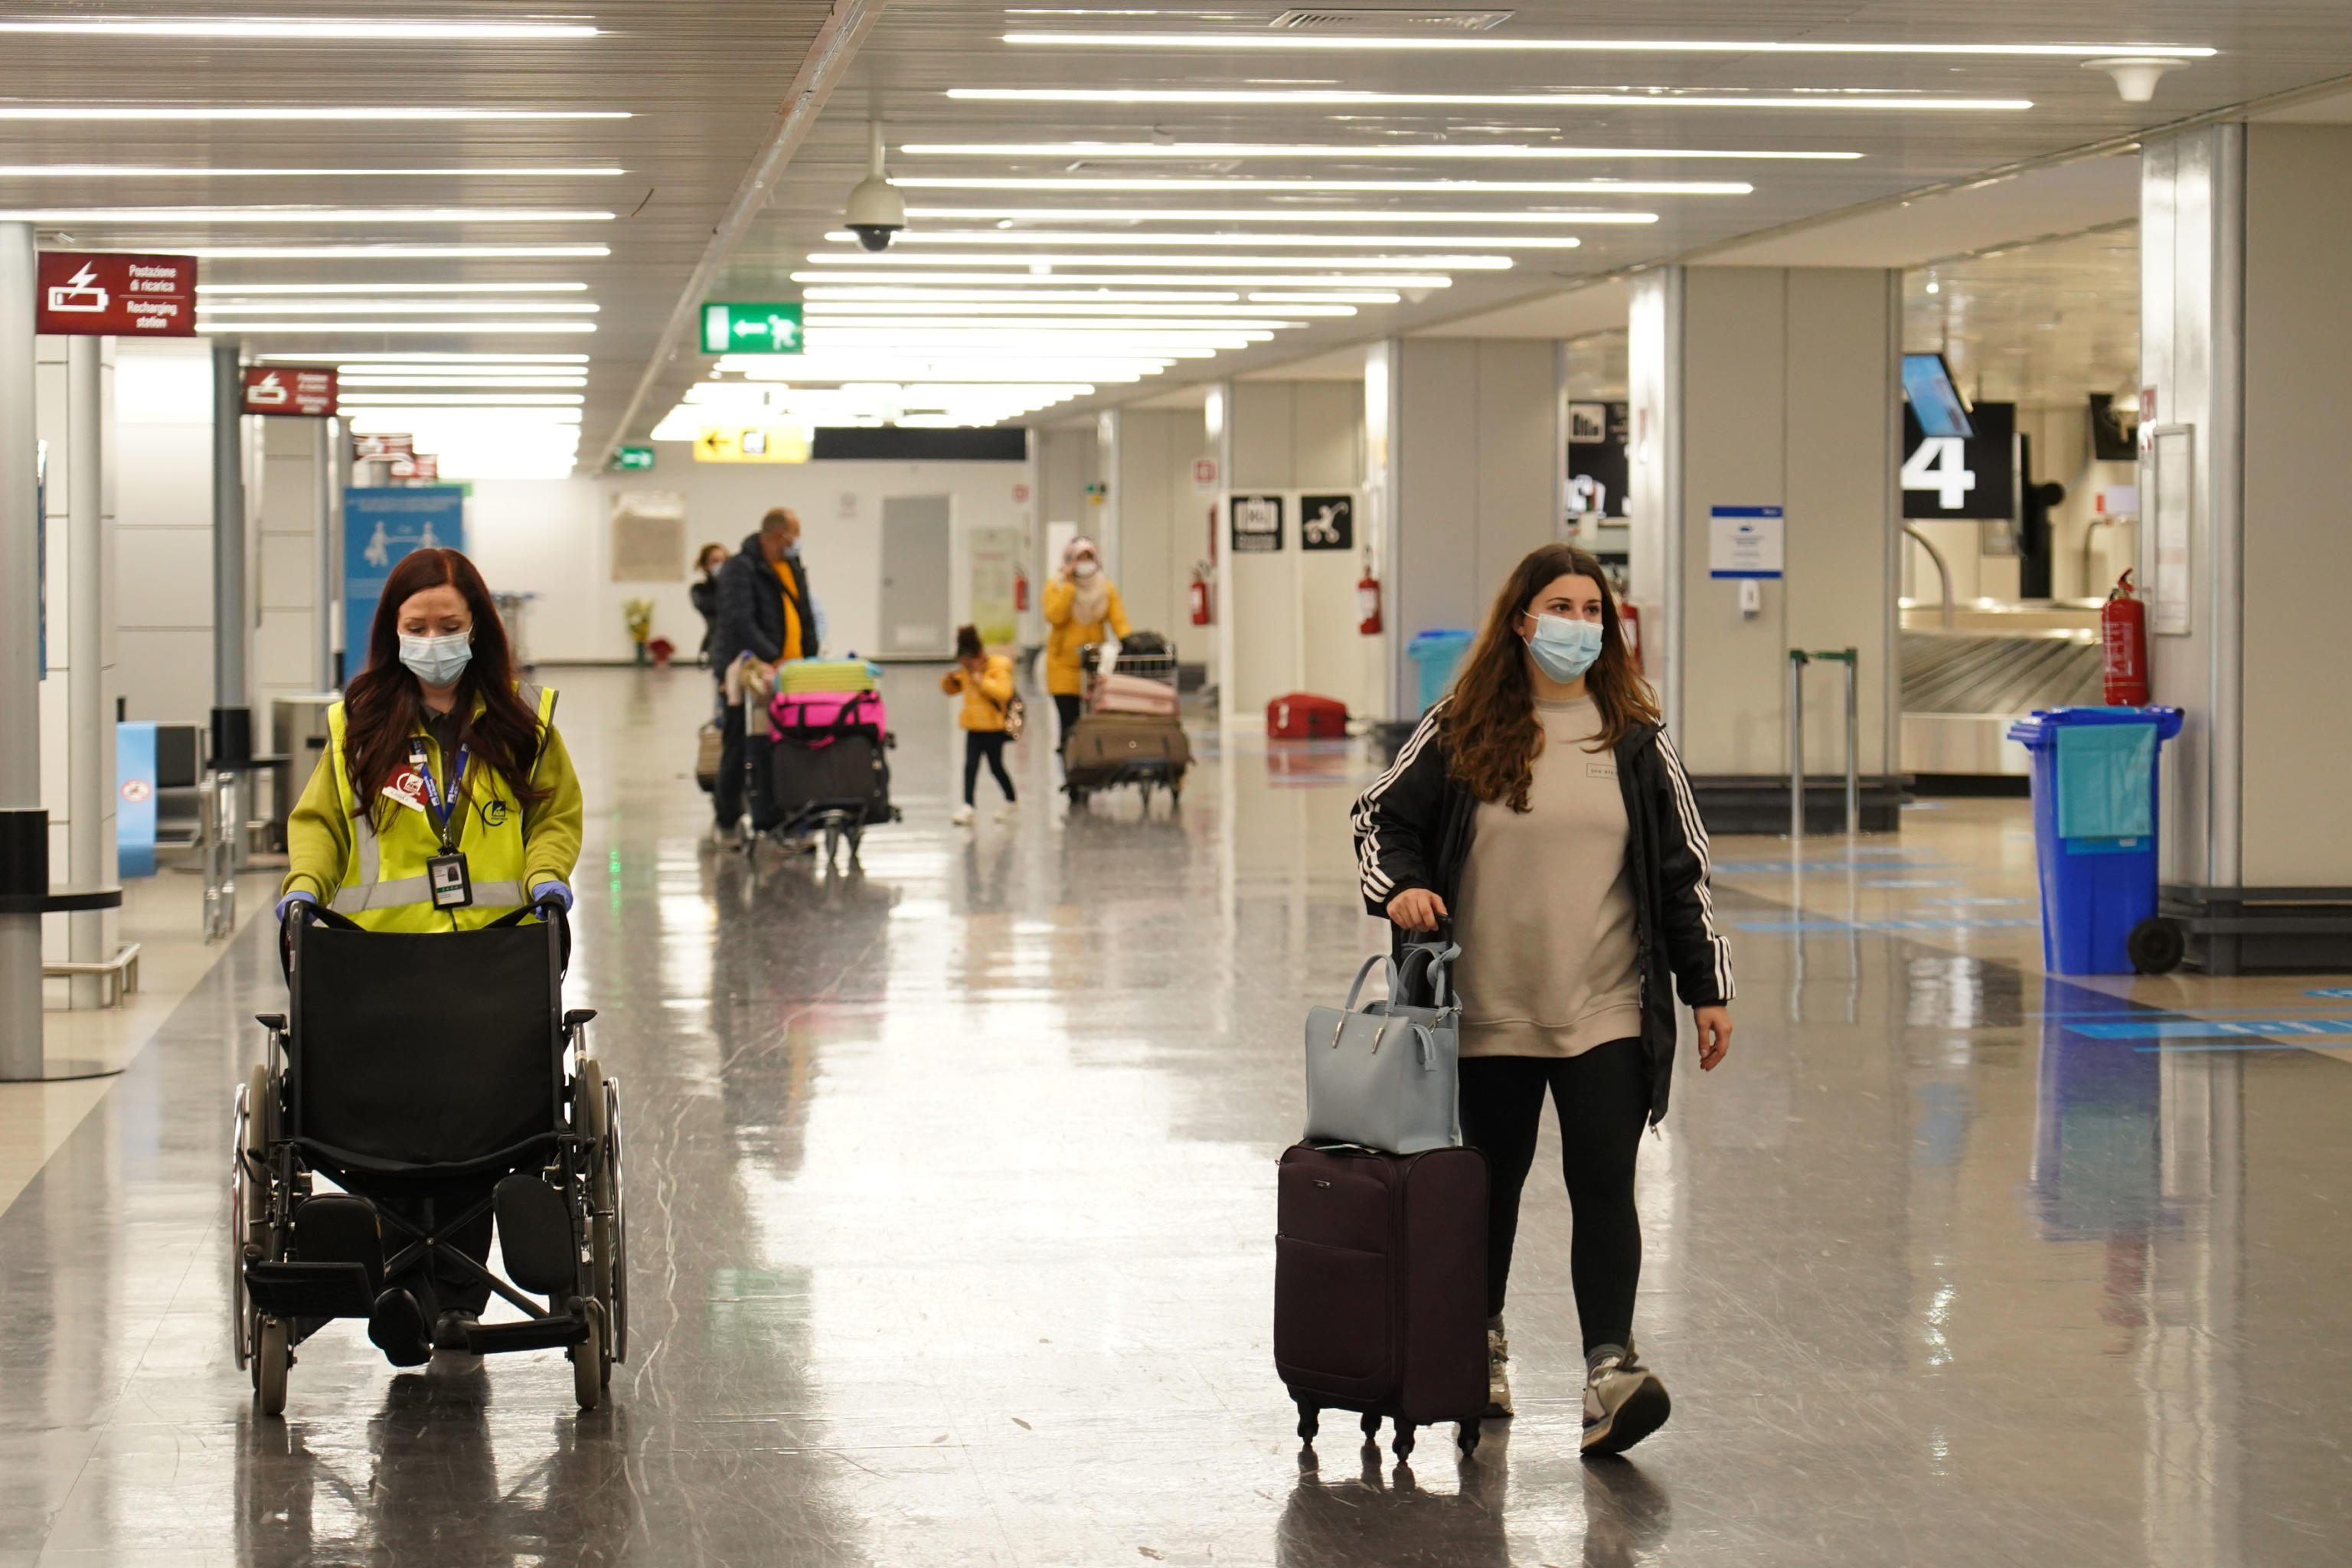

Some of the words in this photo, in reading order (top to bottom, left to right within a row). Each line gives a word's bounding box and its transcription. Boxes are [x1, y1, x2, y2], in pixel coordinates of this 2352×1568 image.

[129, 264, 177, 278] Postazione
[129, 279, 139, 292] di
[141, 279, 175, 292] ricarica
[126, 300, 178, 316] Recharging
[136, 316, 167, 328] station
[1900, 437, 1975, 509] 4
